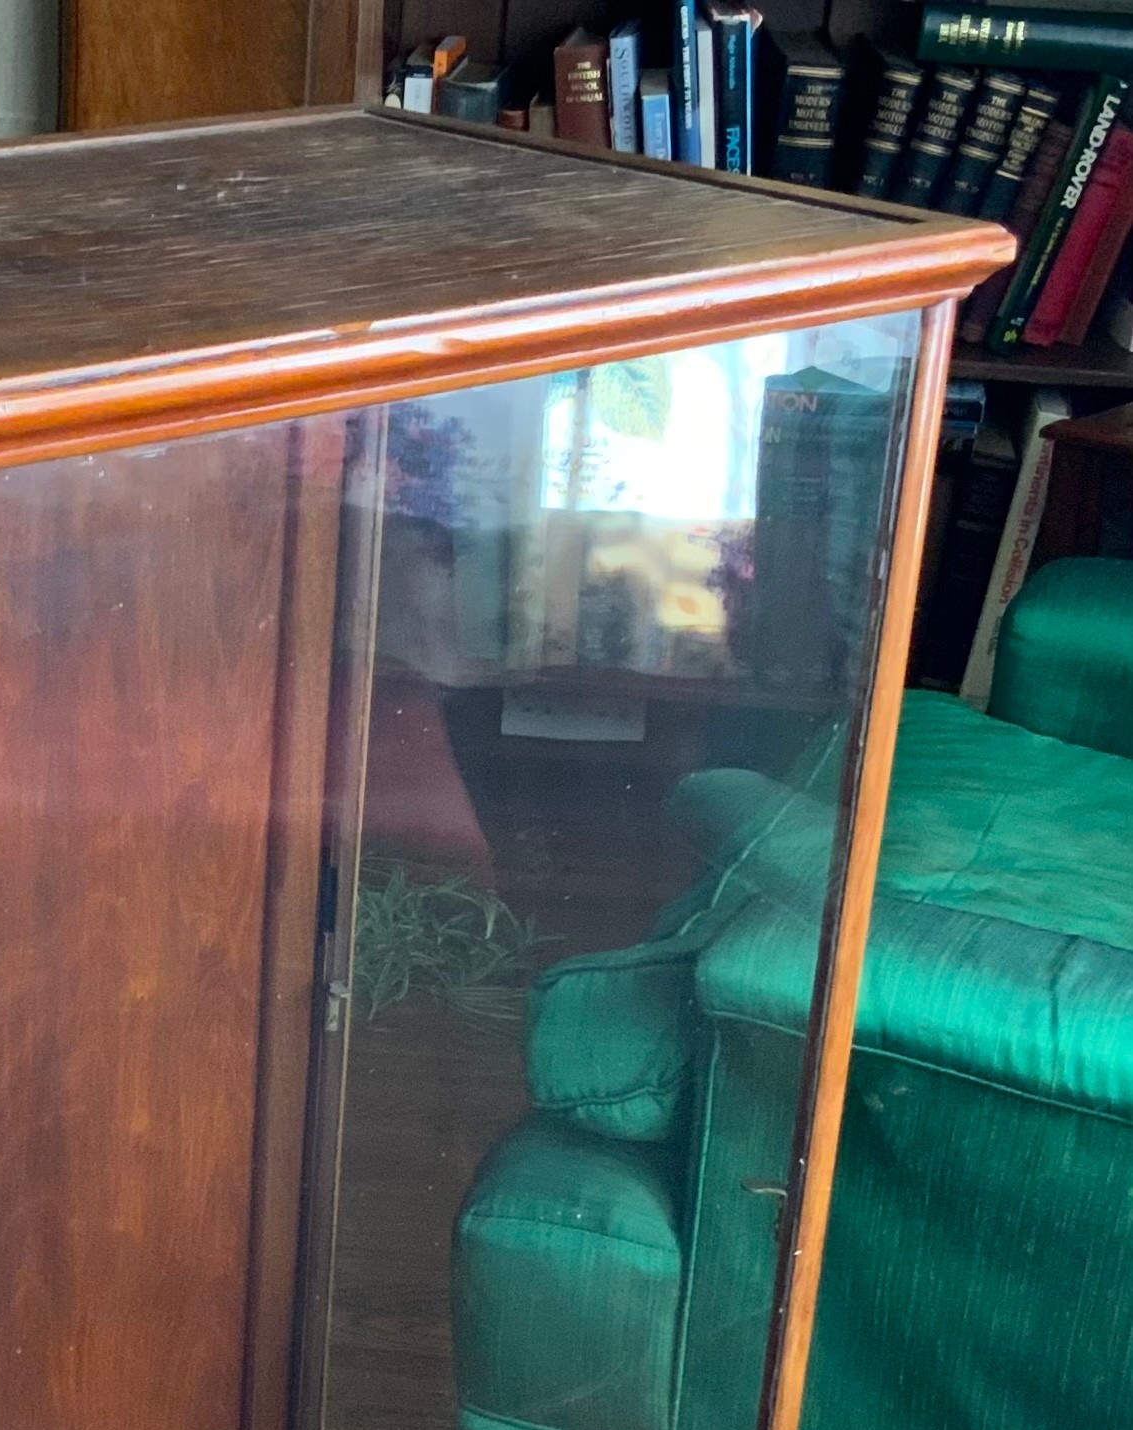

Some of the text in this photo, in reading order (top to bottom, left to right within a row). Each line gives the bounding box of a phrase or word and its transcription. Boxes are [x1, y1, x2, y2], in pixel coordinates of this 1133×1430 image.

[577, 61, 591, 69] THE
[568, 70, 601, 80] BRITISH
[806, 85, 823, 94] THE
[891, 88, 907, 99] THE
[566, 92, 603, 103] MANUAL
[614, 47, 635, 145] SOUTHWOLD
[794, 95, 831, 106] MODERN
[942, 90, 959, 102] THE
[990, 95, 1008, 108] THE
[796, 108, 827, 120] MOTOR
[877, 108, 908, 123] MOTOR
[927, 112, 958, 128] MOTOR
[976, 117, 1006, 132] MOTOR
[1060, 94, 1121, 210] LAND-ROVER
[998, 439, 1053, 605] ontinents in Collision
